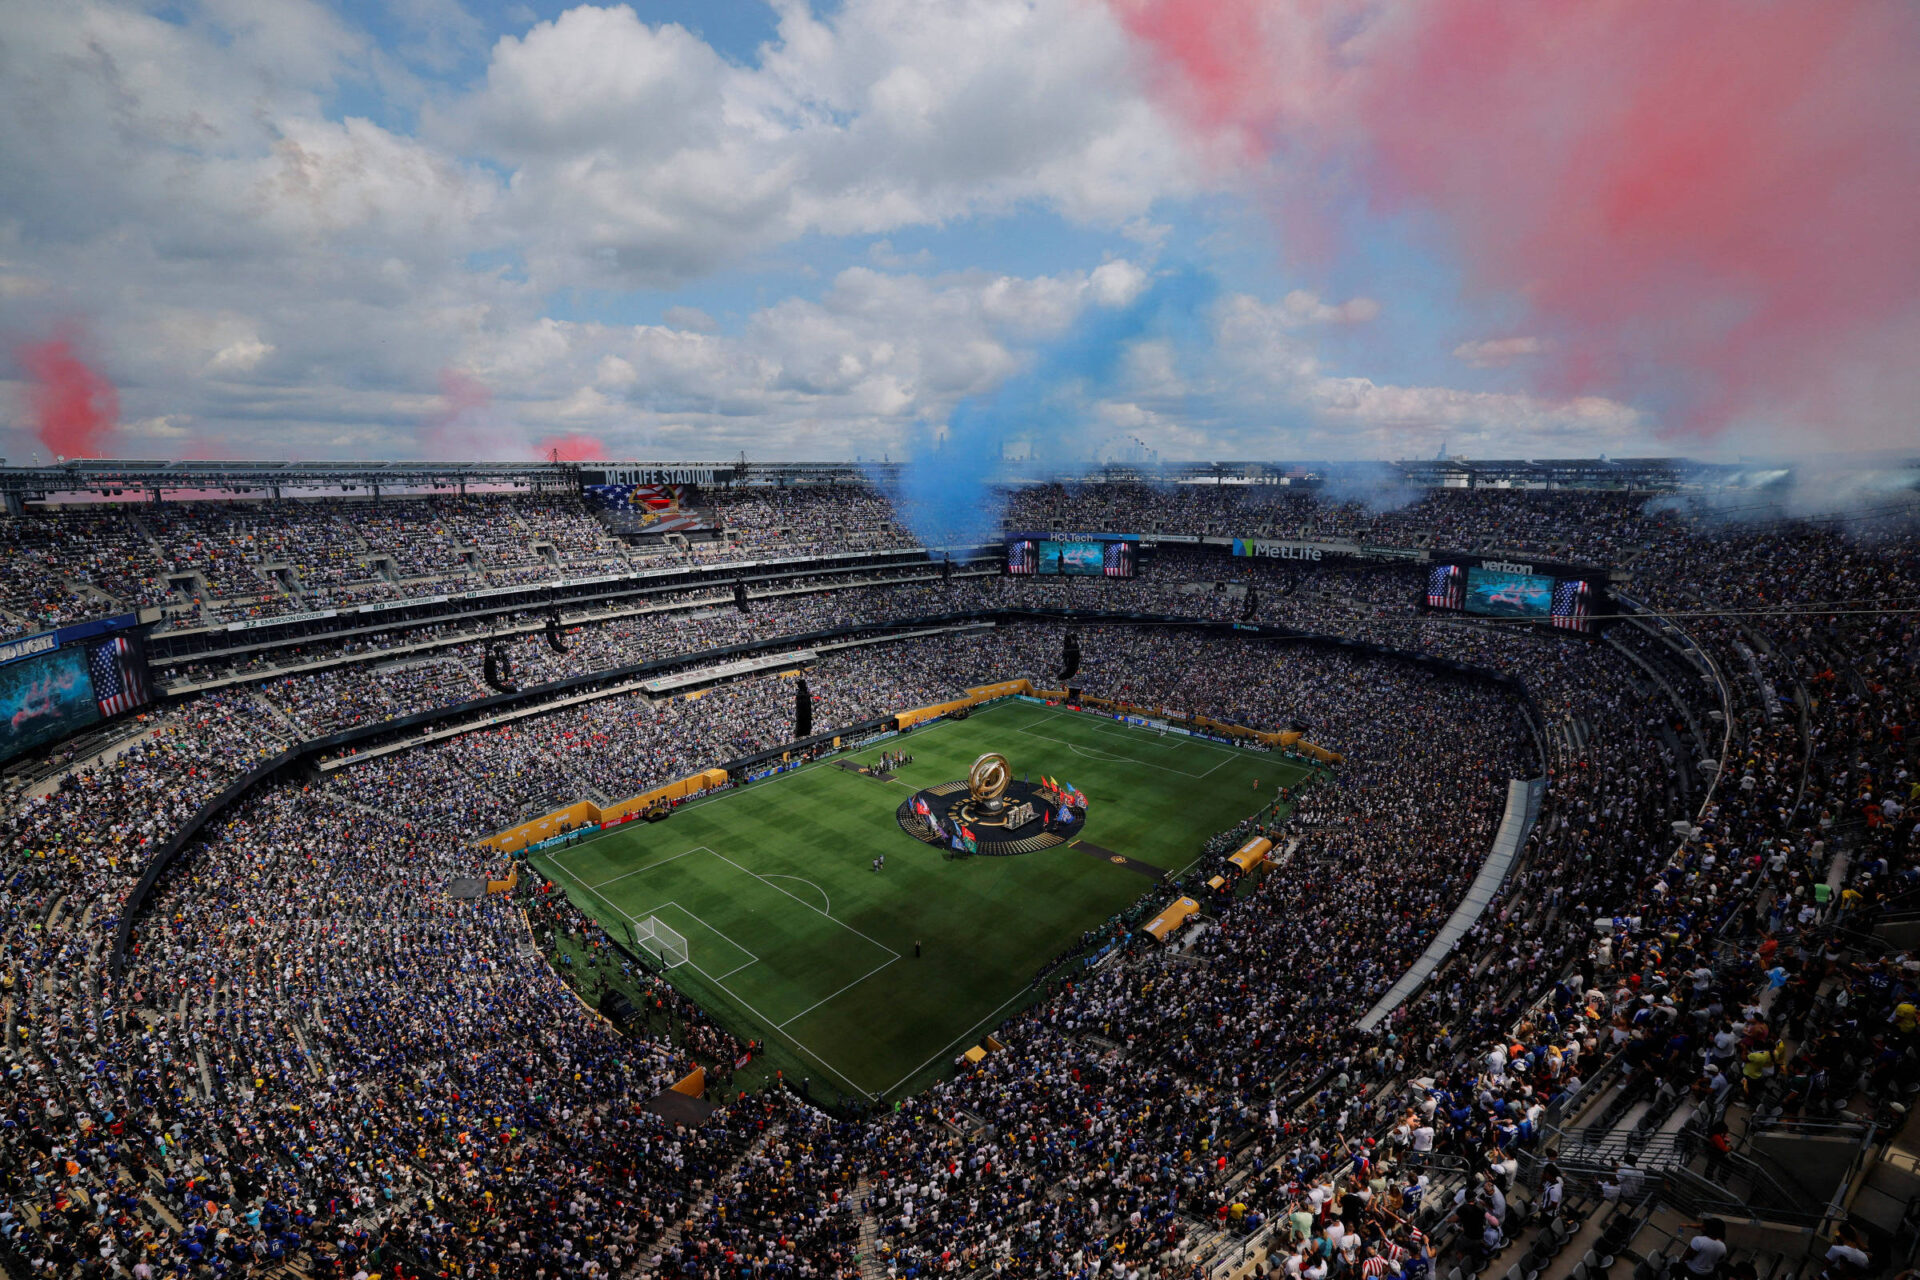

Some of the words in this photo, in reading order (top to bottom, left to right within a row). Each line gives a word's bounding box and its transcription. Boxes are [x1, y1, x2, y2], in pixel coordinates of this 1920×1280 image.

[606, 470, 658, 486] METLIFE
[662, 469, 713, 484] STADIUM
[1050, 534, 1094, 542] HCLTech
[1254, 542, 1322, 562] MetLife
[1481, 560, 1533, 575] verizon
[243, 620, 256, 628] 32
[261, 616, 296, 626] EMERSON
[297, 612, 325, 621] BOOZER
[16, 634, 54, 654] LIGHT
[686, 790, 707, 802] QATAR
[709, 783, 734, 795] AIRWAYS
[540, 832, 578, 849] Hisense
